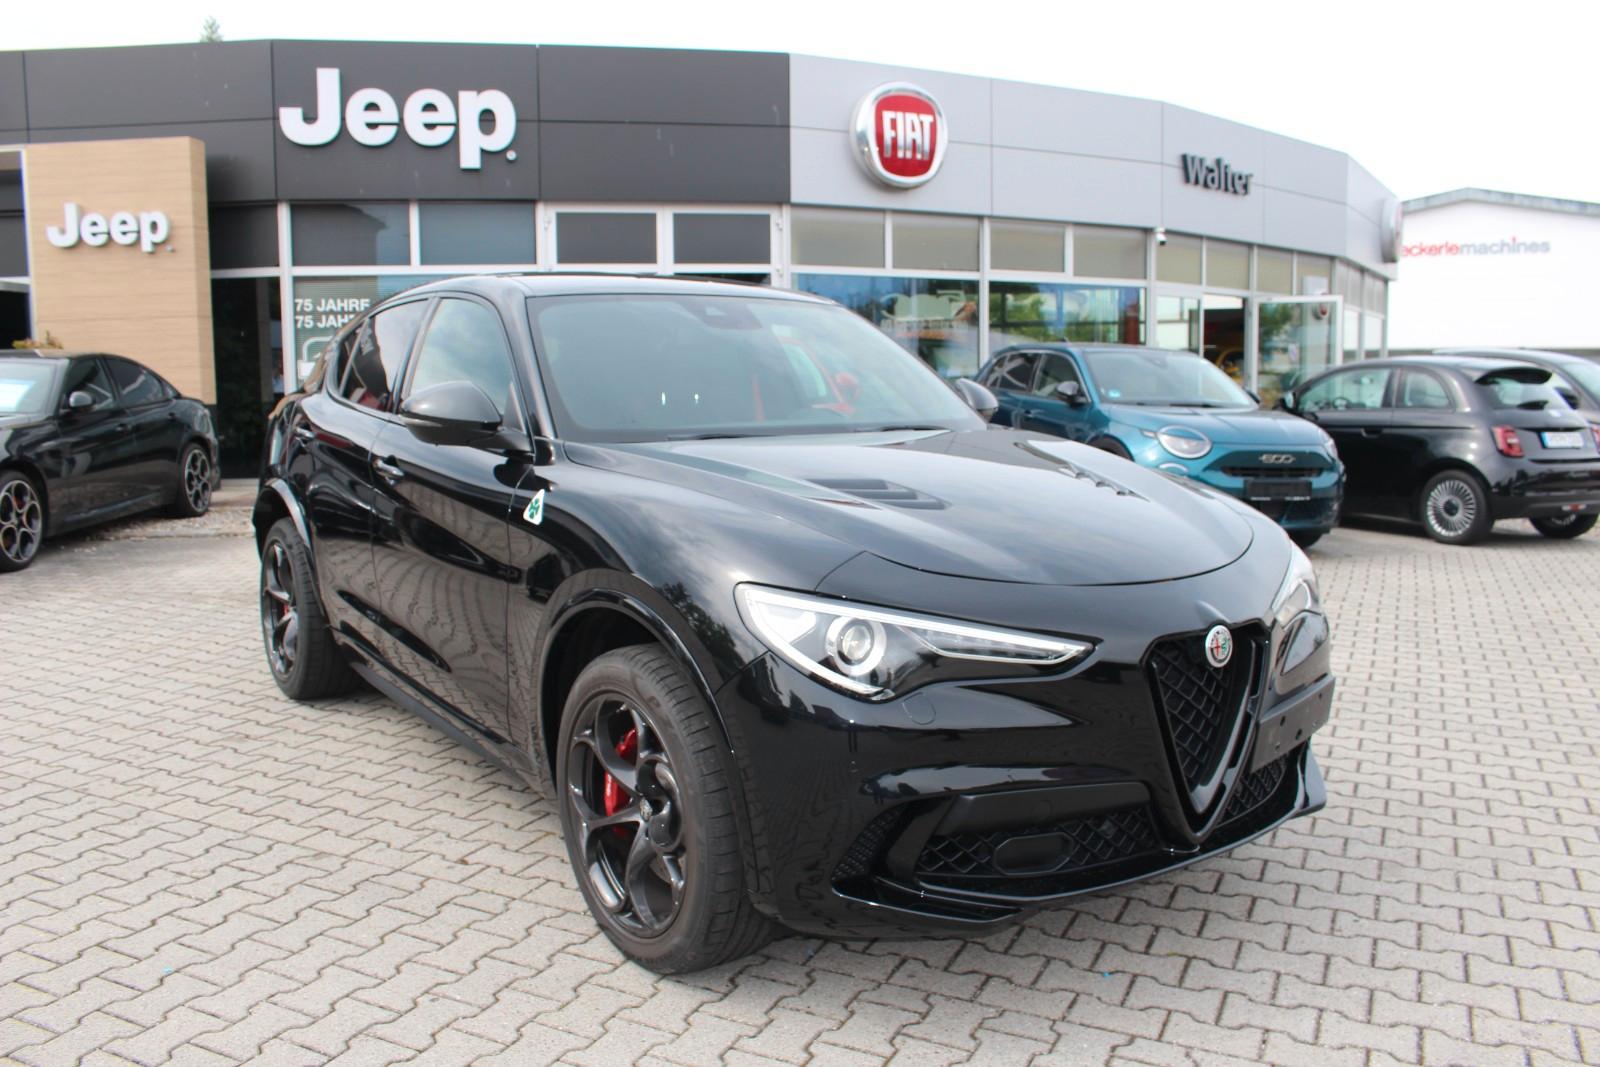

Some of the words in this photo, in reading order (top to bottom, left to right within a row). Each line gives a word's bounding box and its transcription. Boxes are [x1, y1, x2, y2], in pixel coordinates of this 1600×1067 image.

[279, 67, 517, 170] Jeep
[882, 110, 934, 160] FIAT
[1180, 153, 1253, 196] Walter
[46, 202, 170, 253] Jeep
[295, 298, 314, 312] 75
[295, 315, 314, 329] 75
